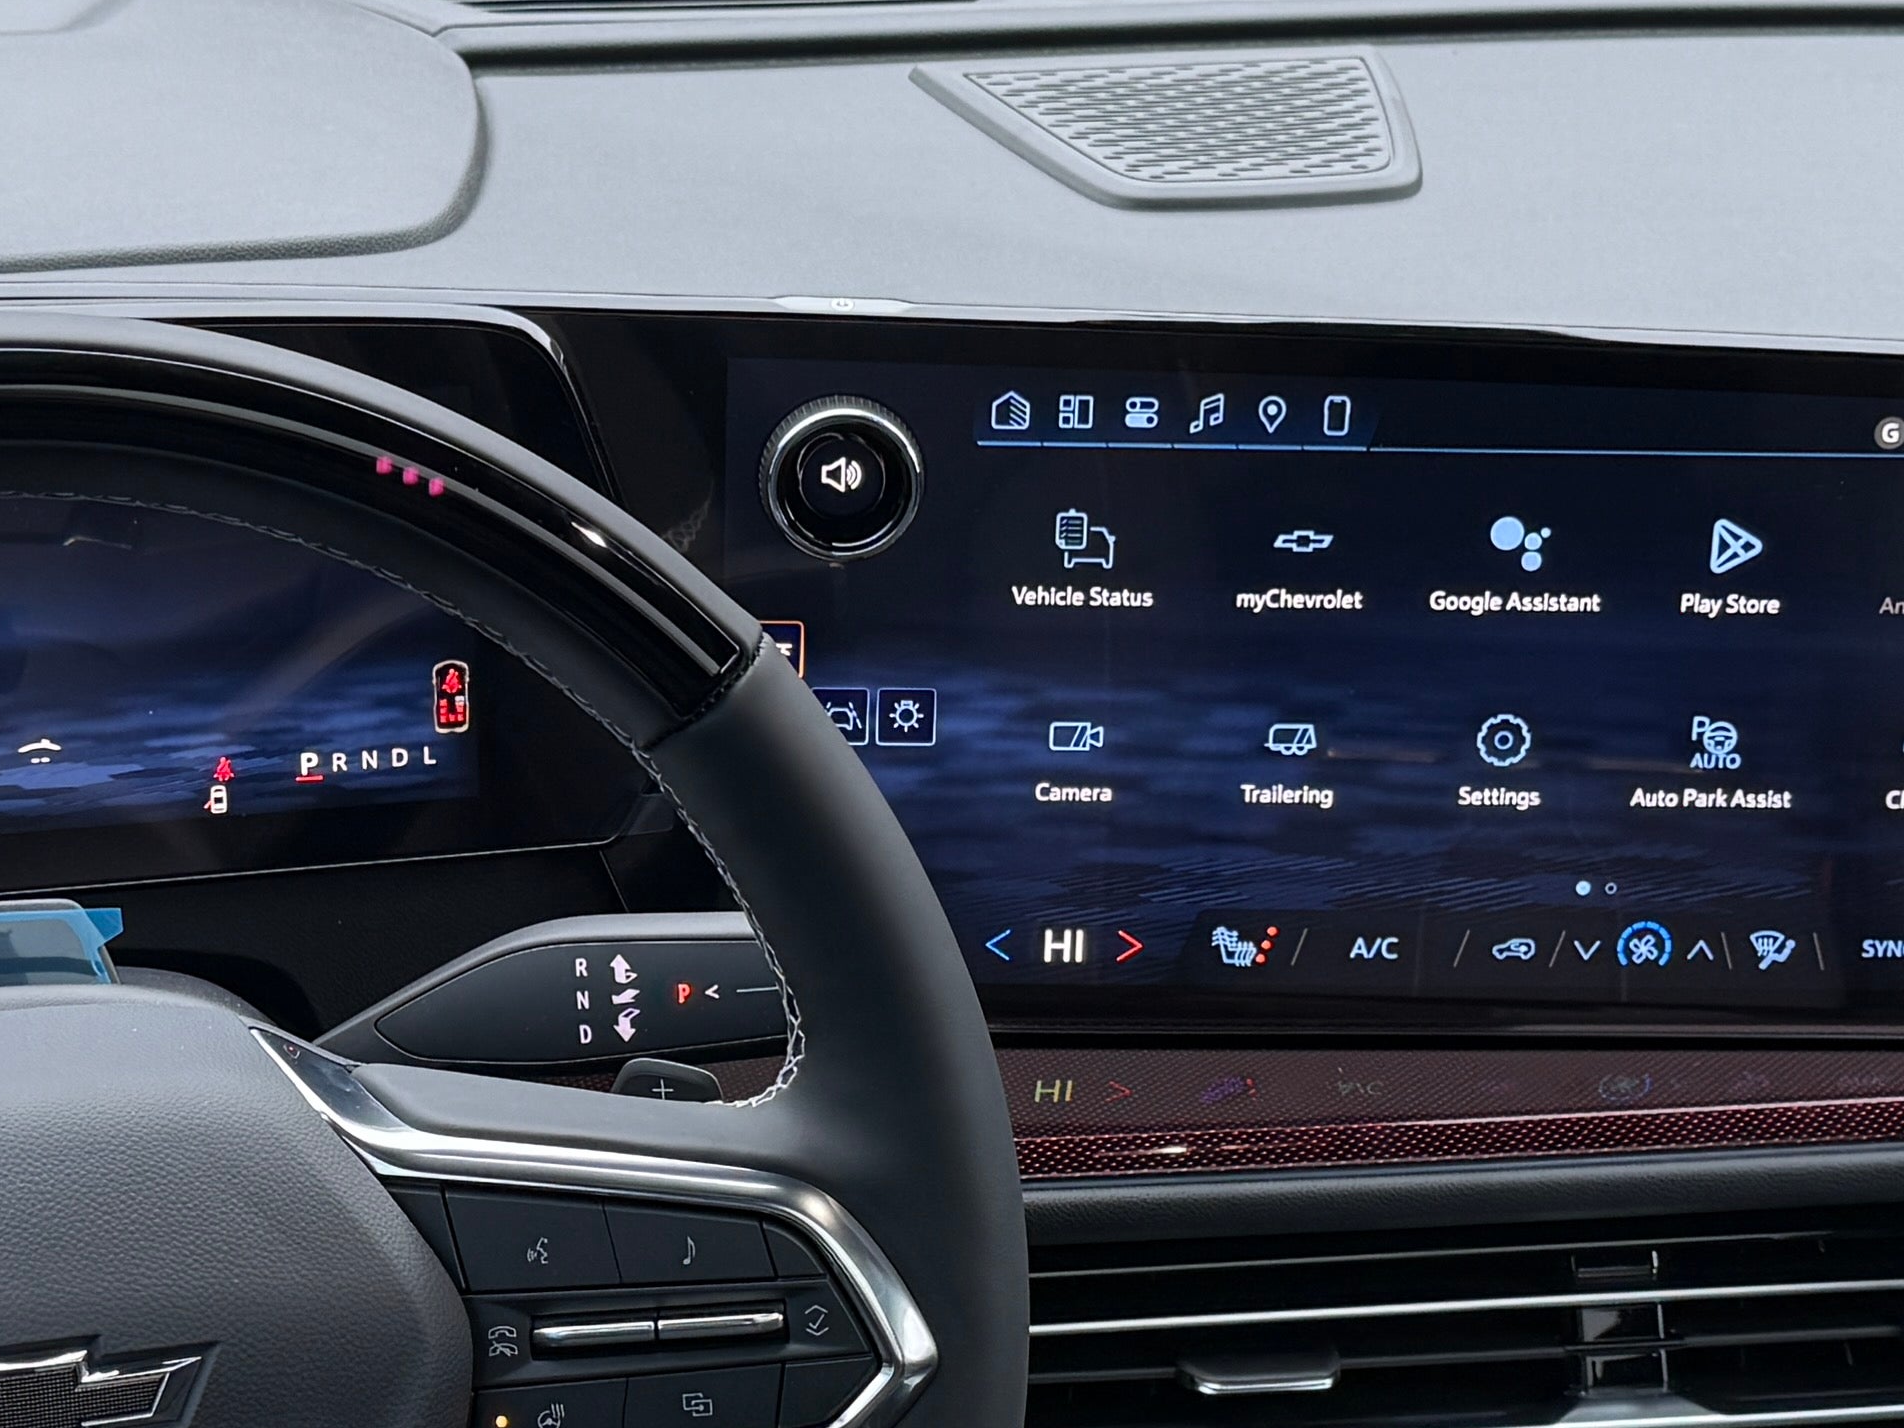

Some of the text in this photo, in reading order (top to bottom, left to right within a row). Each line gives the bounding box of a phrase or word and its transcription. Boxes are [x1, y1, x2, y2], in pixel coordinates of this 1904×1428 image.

[1011, 585, 1154, 608] Vehicle Status
[1236, 588, 1363, 611] myChevrolet
[1429, 590, 1601, 614] Google Assistant
[1680, 594, 1780, 618] Play Store
[300, 746, 437, 776] P R N D L
[1035, 783, 1113, 803] Camera
[1240, 784, 1334, 809] Trailering
[1458, 786, 1541, 811] Settings
[1630, 788, 1792, 810] Auto Park Assist
[1043, 929, 1084, 963] HI
[1350, 936, 1399, 960] A/C
[576, 959, 588, 977] R
[577, 991, 590, 1009] N
[677, 983, 691, 1003] P
[580, 1025, 593, 1044] D
